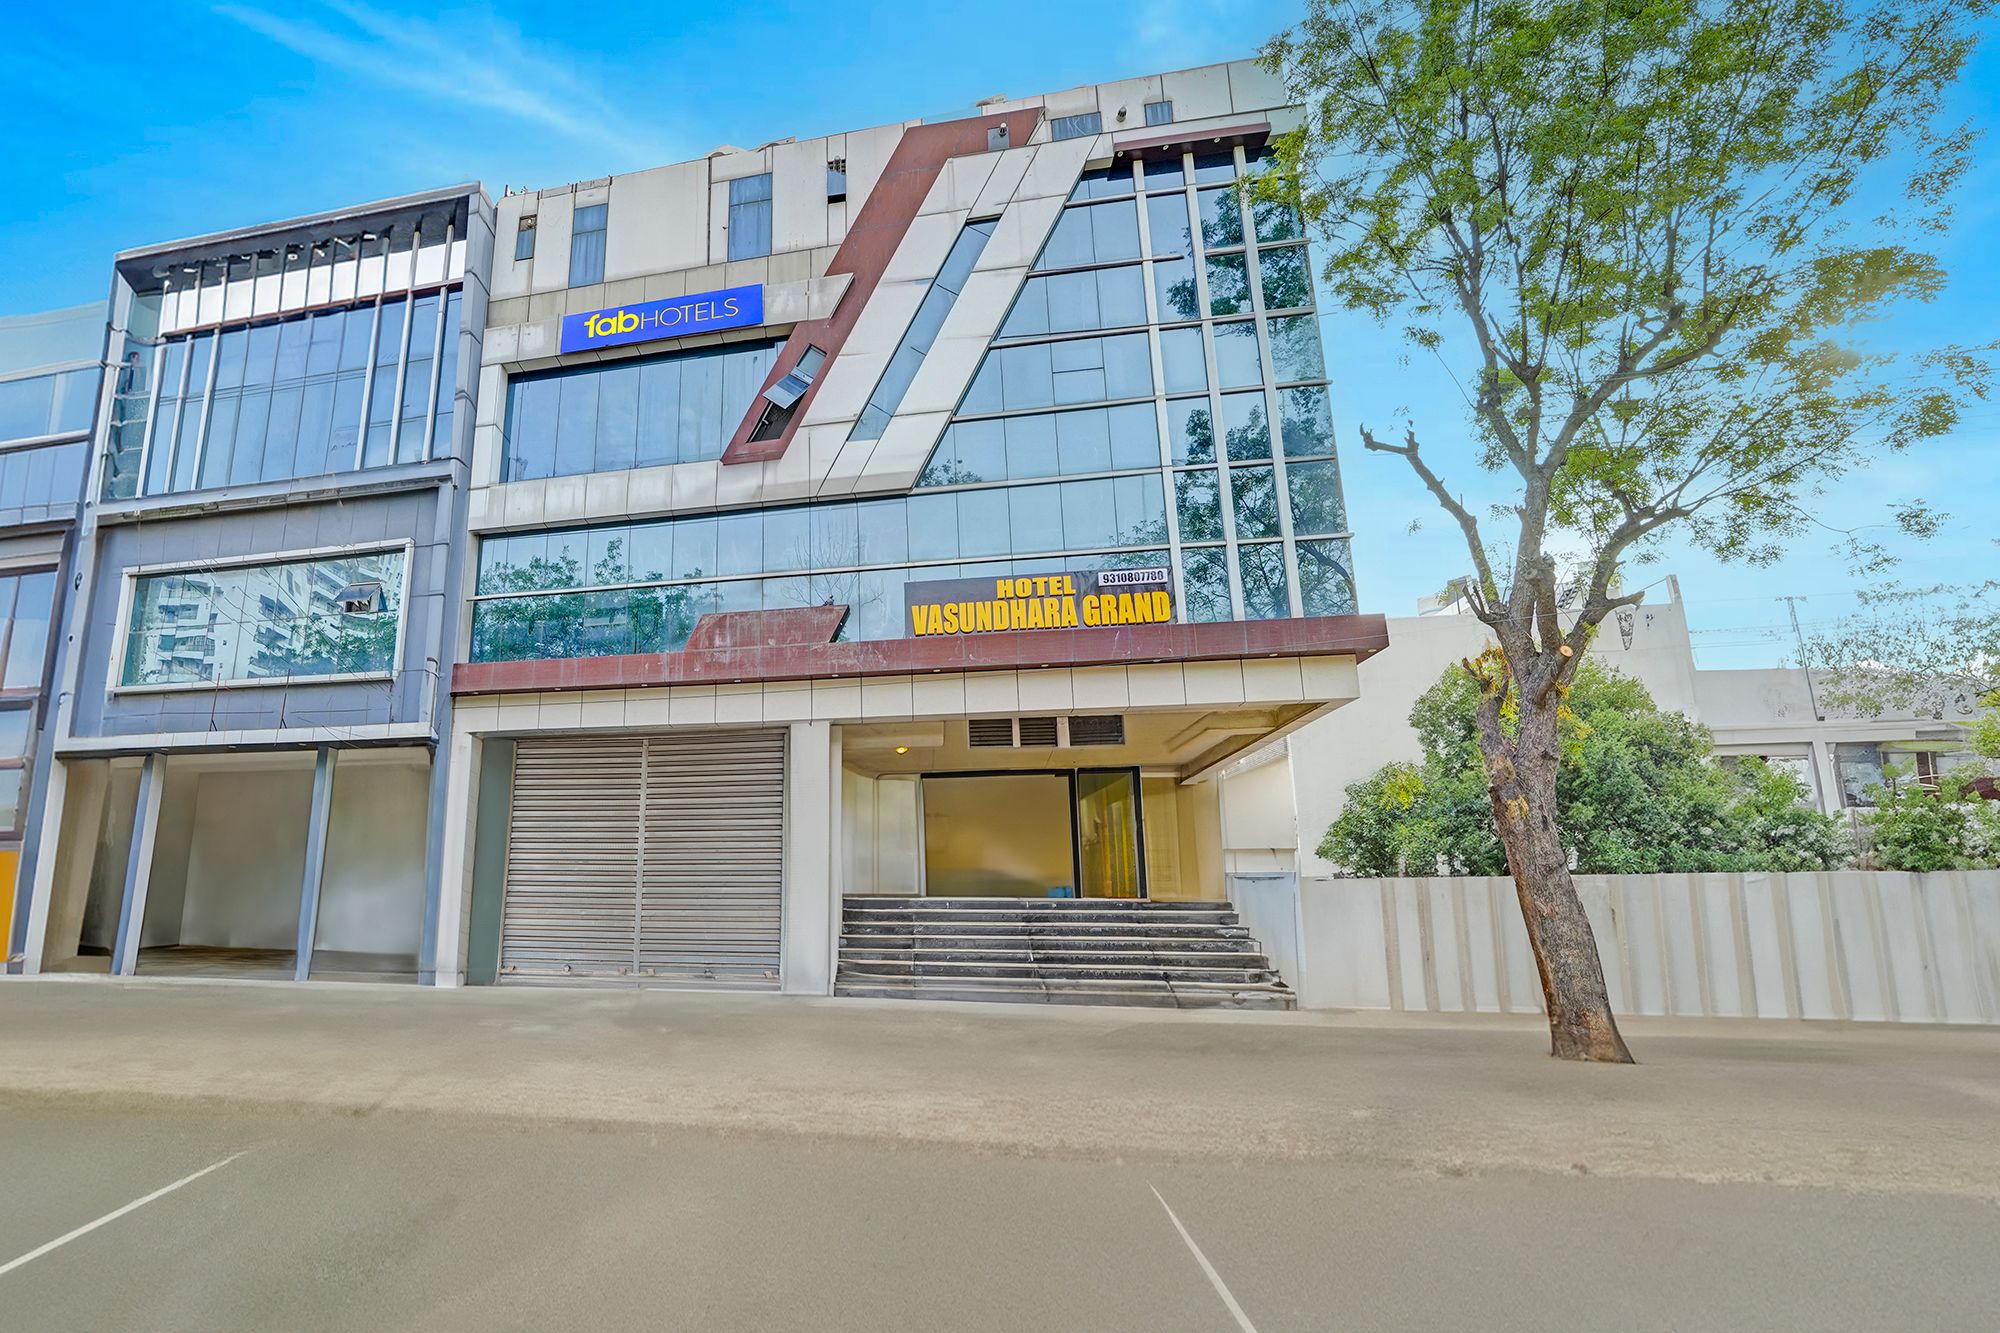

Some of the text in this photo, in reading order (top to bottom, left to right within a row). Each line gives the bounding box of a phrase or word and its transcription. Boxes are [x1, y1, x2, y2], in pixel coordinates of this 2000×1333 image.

[997, 575, 1076, 599] HOTEL
[1103, 570, 1164, 584] 9310807780
[912, 591, 1172, 637] VASUNDHARA GRAND
